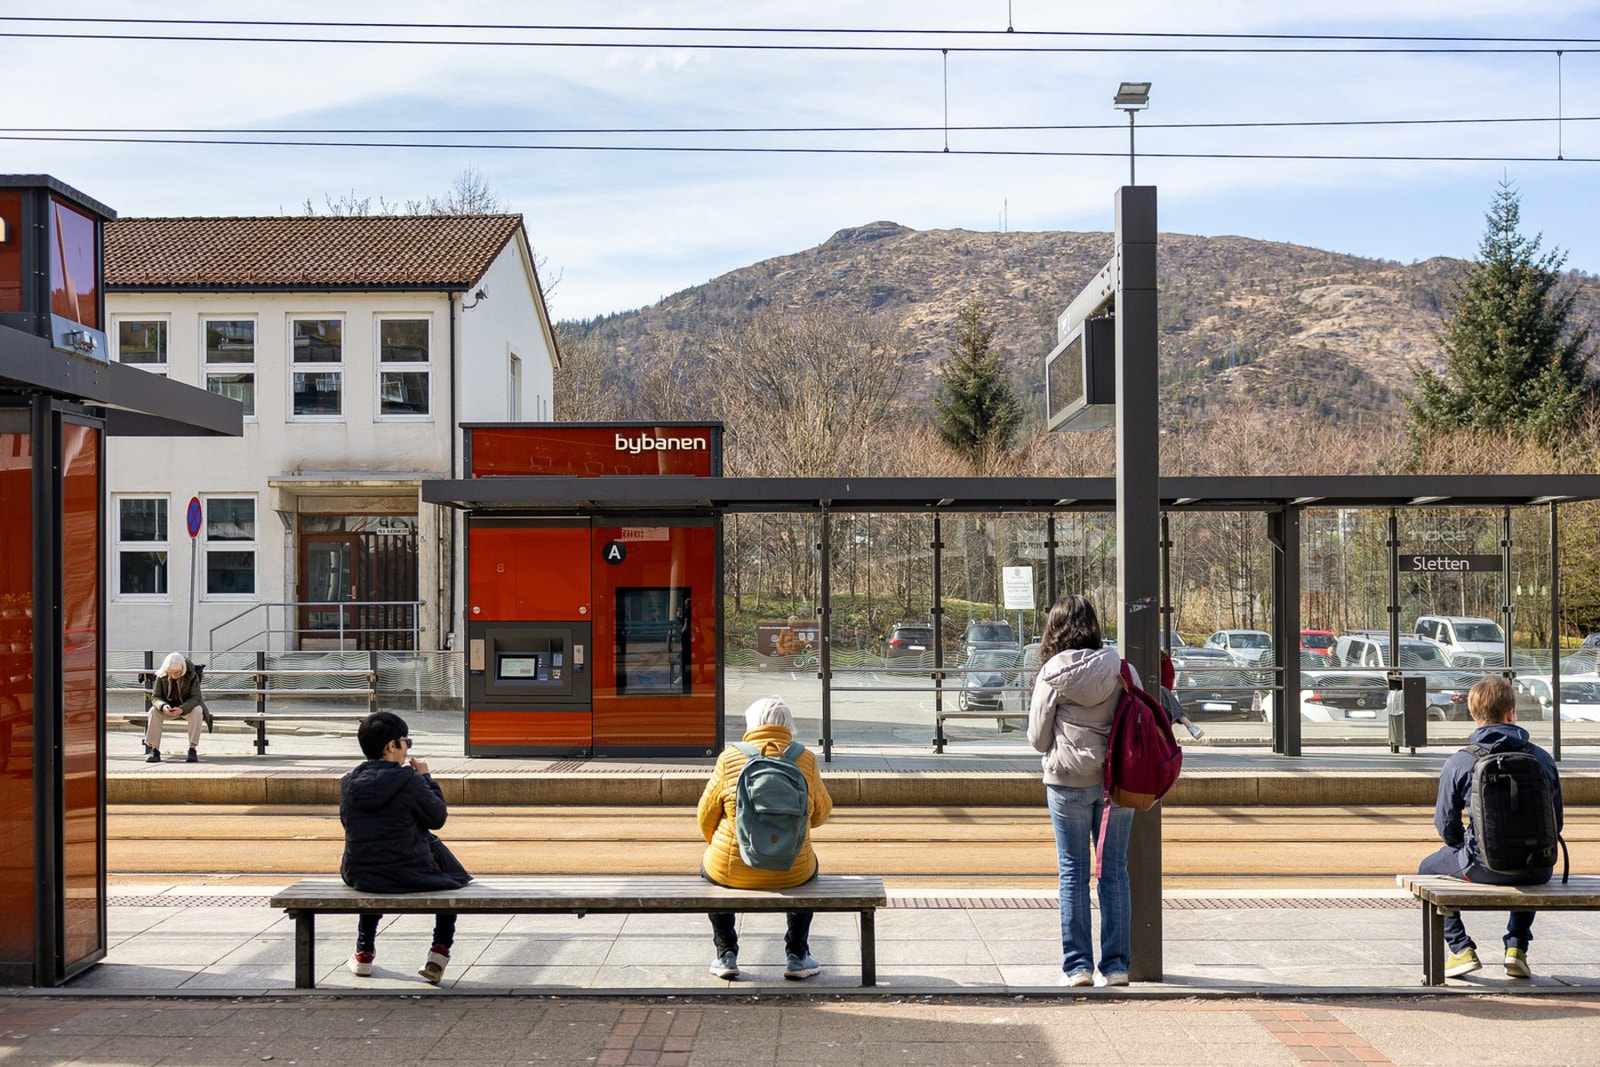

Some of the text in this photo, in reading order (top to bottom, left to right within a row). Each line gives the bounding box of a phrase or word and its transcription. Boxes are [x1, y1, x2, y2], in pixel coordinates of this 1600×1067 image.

[615, 433, 706, 454] bybanen
[608, 544, 621, 560] A
[1413, 556, 1470, 571] Sletten
